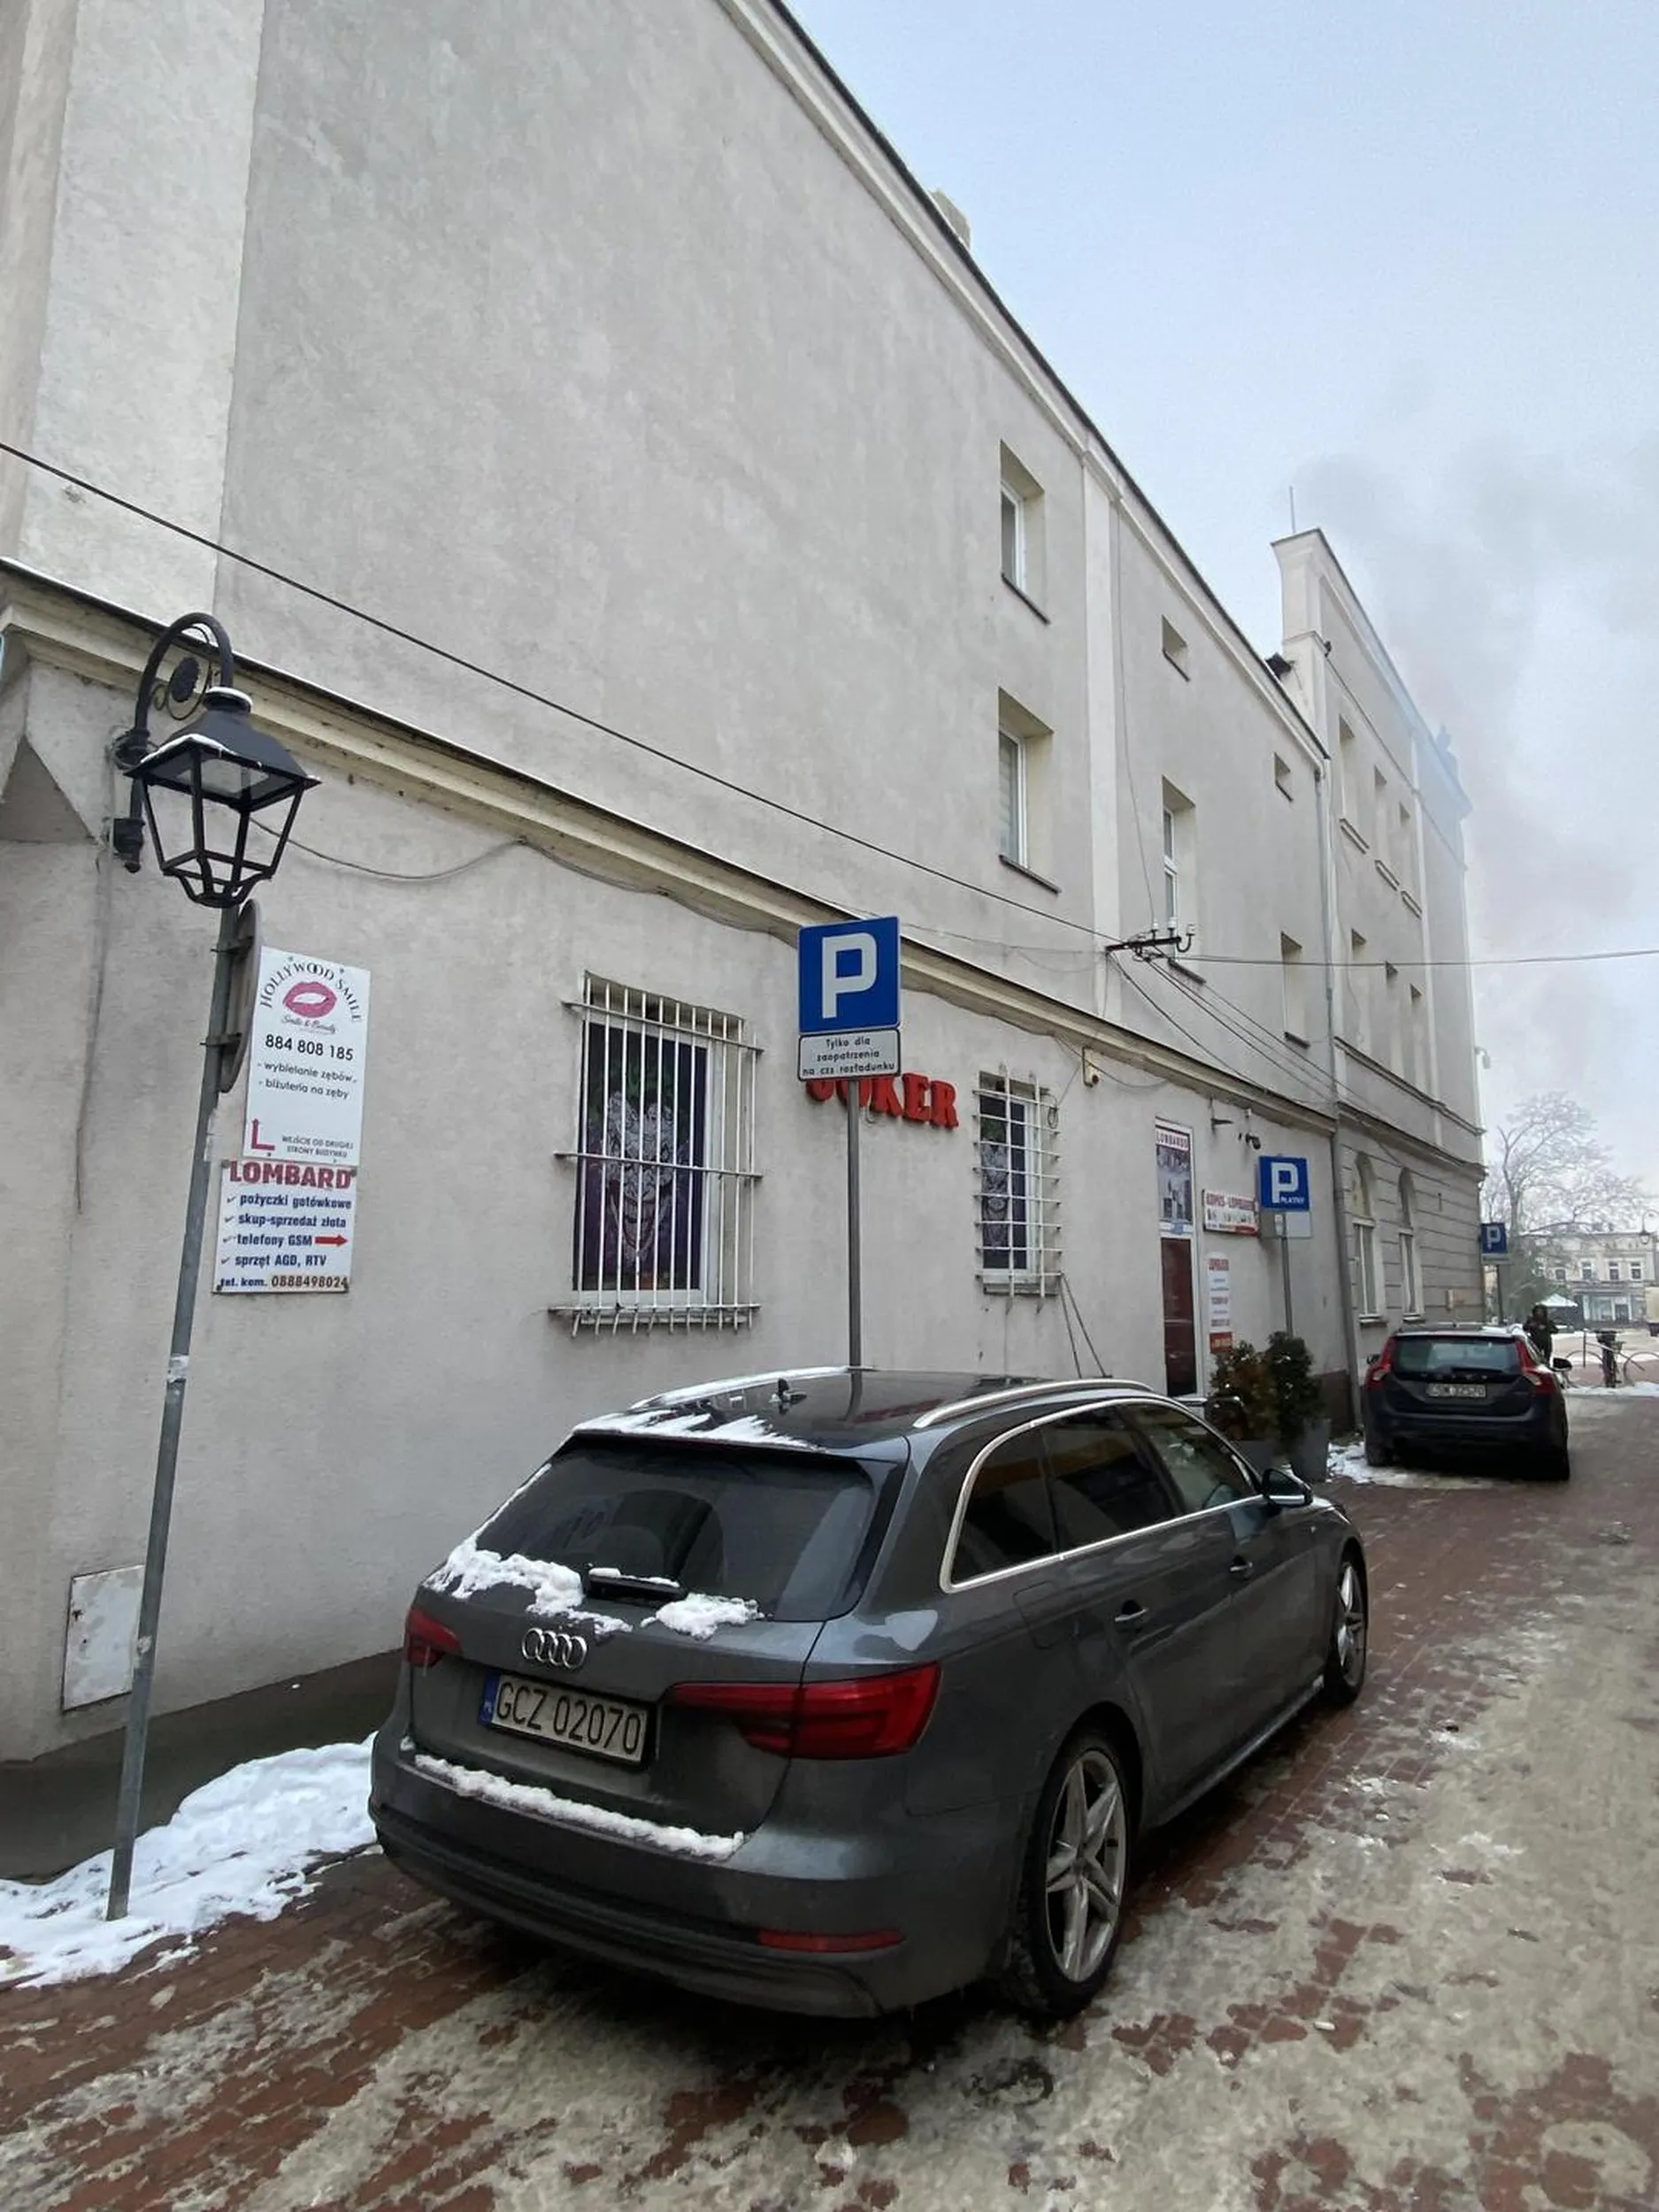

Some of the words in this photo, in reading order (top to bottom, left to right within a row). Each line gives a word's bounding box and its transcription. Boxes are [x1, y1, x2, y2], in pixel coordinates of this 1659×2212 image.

[822, 933, 877, 1018] P
[260, 963, 334, 1008] HOLLYWOOD
[338, 979, 361, 1023] SMILE
[265, 1034, 293, 1050] 884
[297, 1040, 324, 1056] 808
[330, 1045, 354, 1061] 185
[826, 1038, 849, 1050] Tylko
[854, 1036, 871, 1046] dla
[817, 1050, 879, 1063] zaopatrzenia
[265, 1062, 319, 1078] wybielanie
[311, 1087, 324, 1095] na
[326, 1089, 349, 1100] zęby
[230, 1160, 351, 1189] LOMBARD
[1271, 1162, 1299, 1203] P
[240, 1193, 288, 1207] pożyczki
[293, 1194, 352, 1210] gotówkowe
[238, 1213, 317, 1228] skup-sprzedaż
[320, 1217, 347, 1228] złota
[237, 1233, 284, 1248] telefony
[288, 1234, 312, 1246] GSM
[234, 1254, 270, 1269] sprzęt
[274, 1255, 301, 1268] AGD,
[305, 1255, 327, 1267] RTV
[220, 1278, 238, 1287] tel.
[241, 1278, 268, 1287] kom.
[496, 1681, 549, 1731] GCZ
[552, 1694, 642, 1755] 02070
